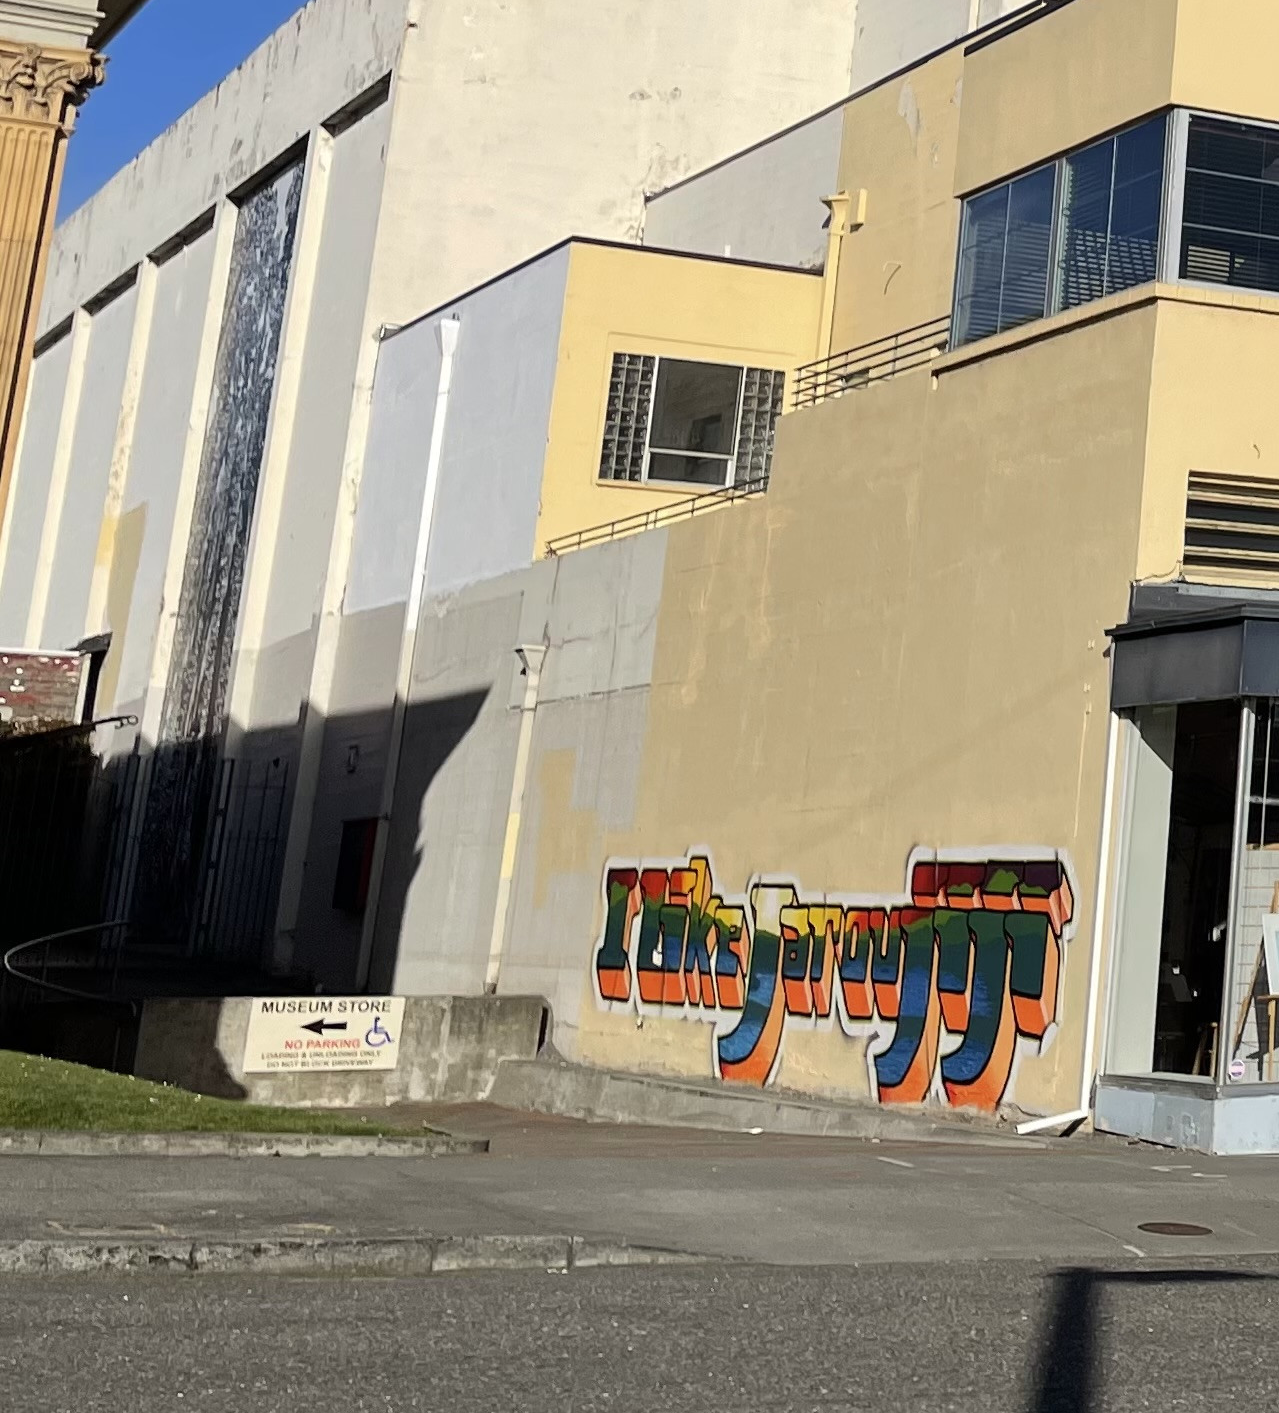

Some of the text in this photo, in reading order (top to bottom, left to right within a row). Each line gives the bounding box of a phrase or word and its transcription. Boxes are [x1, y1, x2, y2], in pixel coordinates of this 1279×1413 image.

[261, 999, 392, 1014] MUSEUM STORE
[284, 1038, 361, 1050] NO PARKING
